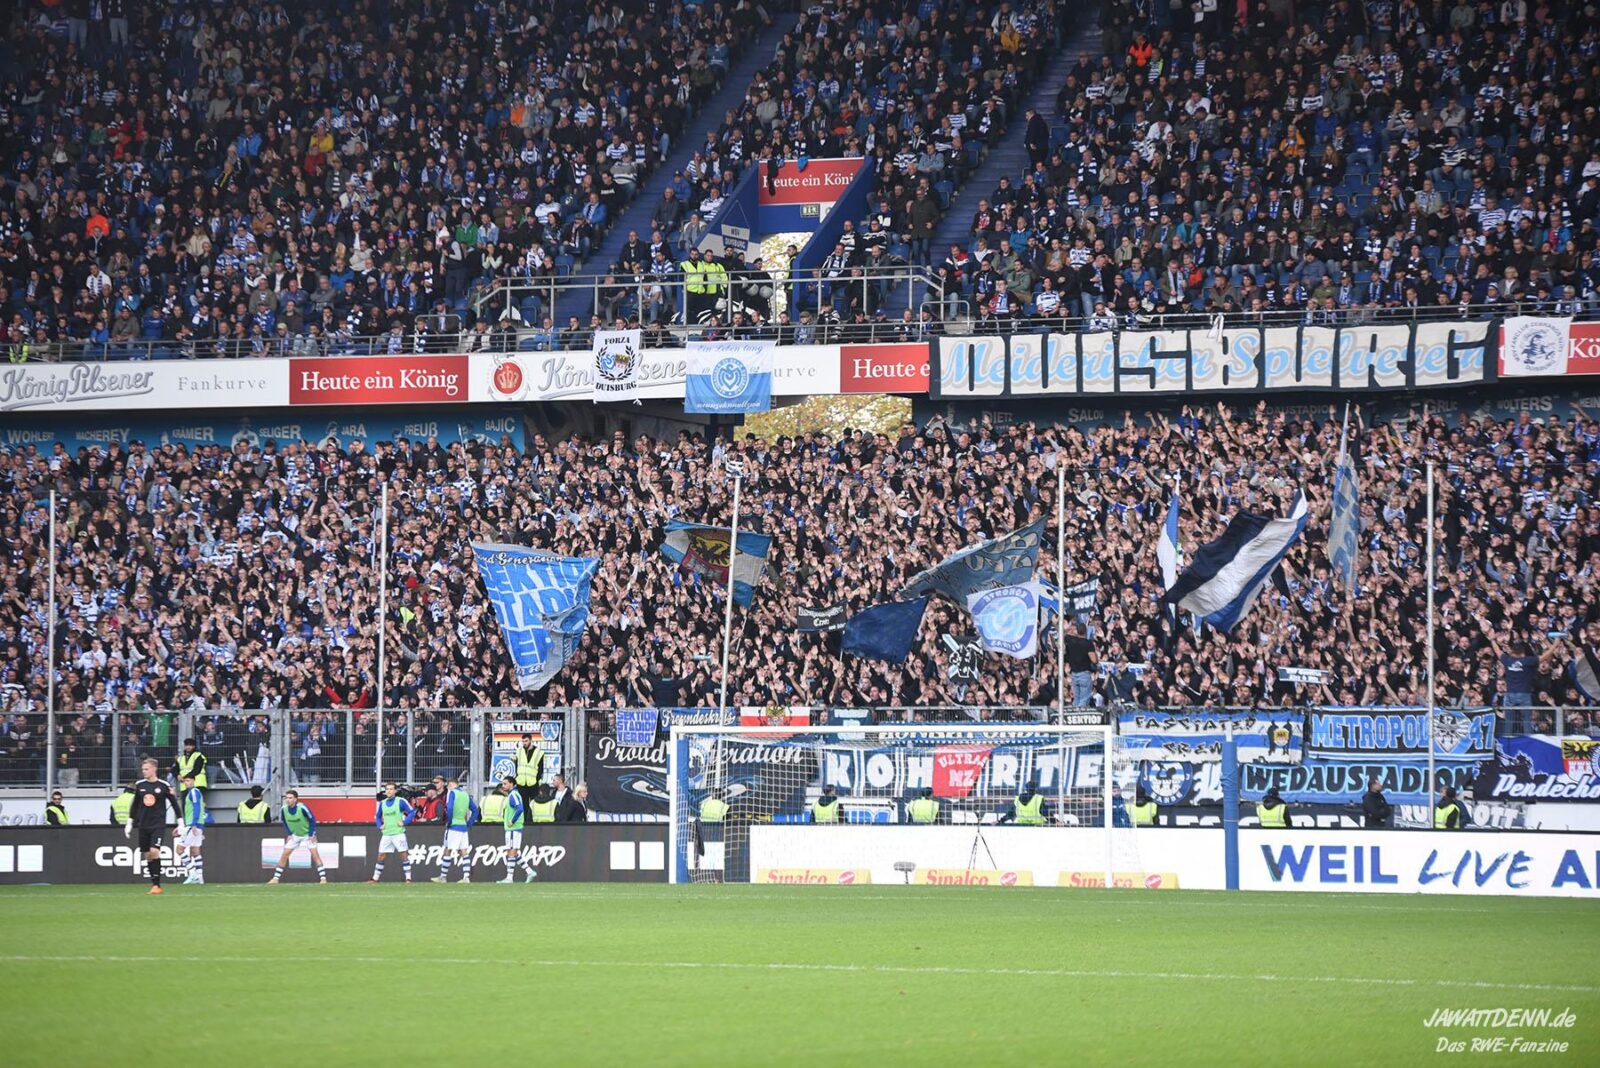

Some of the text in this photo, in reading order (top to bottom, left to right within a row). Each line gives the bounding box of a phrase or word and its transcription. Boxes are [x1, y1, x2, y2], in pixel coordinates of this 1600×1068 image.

[802, 174, 821, 187] ein
[604, 336, 630, 346] FORZA
[697, 343, 712, 352] Ein
[852, 357, 920, 379] Heute
[0, 361, 154, 402] König Pilsener
[178, 374, 267, 391] Fankurve
[300, 368, 459, 397] Heute ein König
[595, 381, 637, 393] DUISBURG
[1496, 396, 1553, 412] WOLTERS
[1068, 407, 1105, 424] SALOU
[259, 424, 302, 440] SELIGER
[341, 423, 367, 438] JARA
[484, 417, 515, 433] BAJIC
[76, 428, 130, 443] MACHEREY
[172, 426, 215, 441] KRÄMER
[617, 711, 657, 721] SEKTION
[661, 708, 736, 728] Freundeskris
[494, 722, 541, 732] SEKTION
[1469, 713, 1496, 750] 47
[595, 736, 667, 764] Proud
[937, 753, 990, 769] ULTRAS
[827, 752, 1104, 789] KOHRTE
[1246, 765, 1473, 794] WEDAUSTADION
[1260, 845, 1399, 883] WEIL
[1416, 848, 1536, 889] LIVE
[766, 869, 828, 884] Sinalco
[926, 869, 989, 887] Sinalco
[1069, 871, 1133, 888] Sinaco
